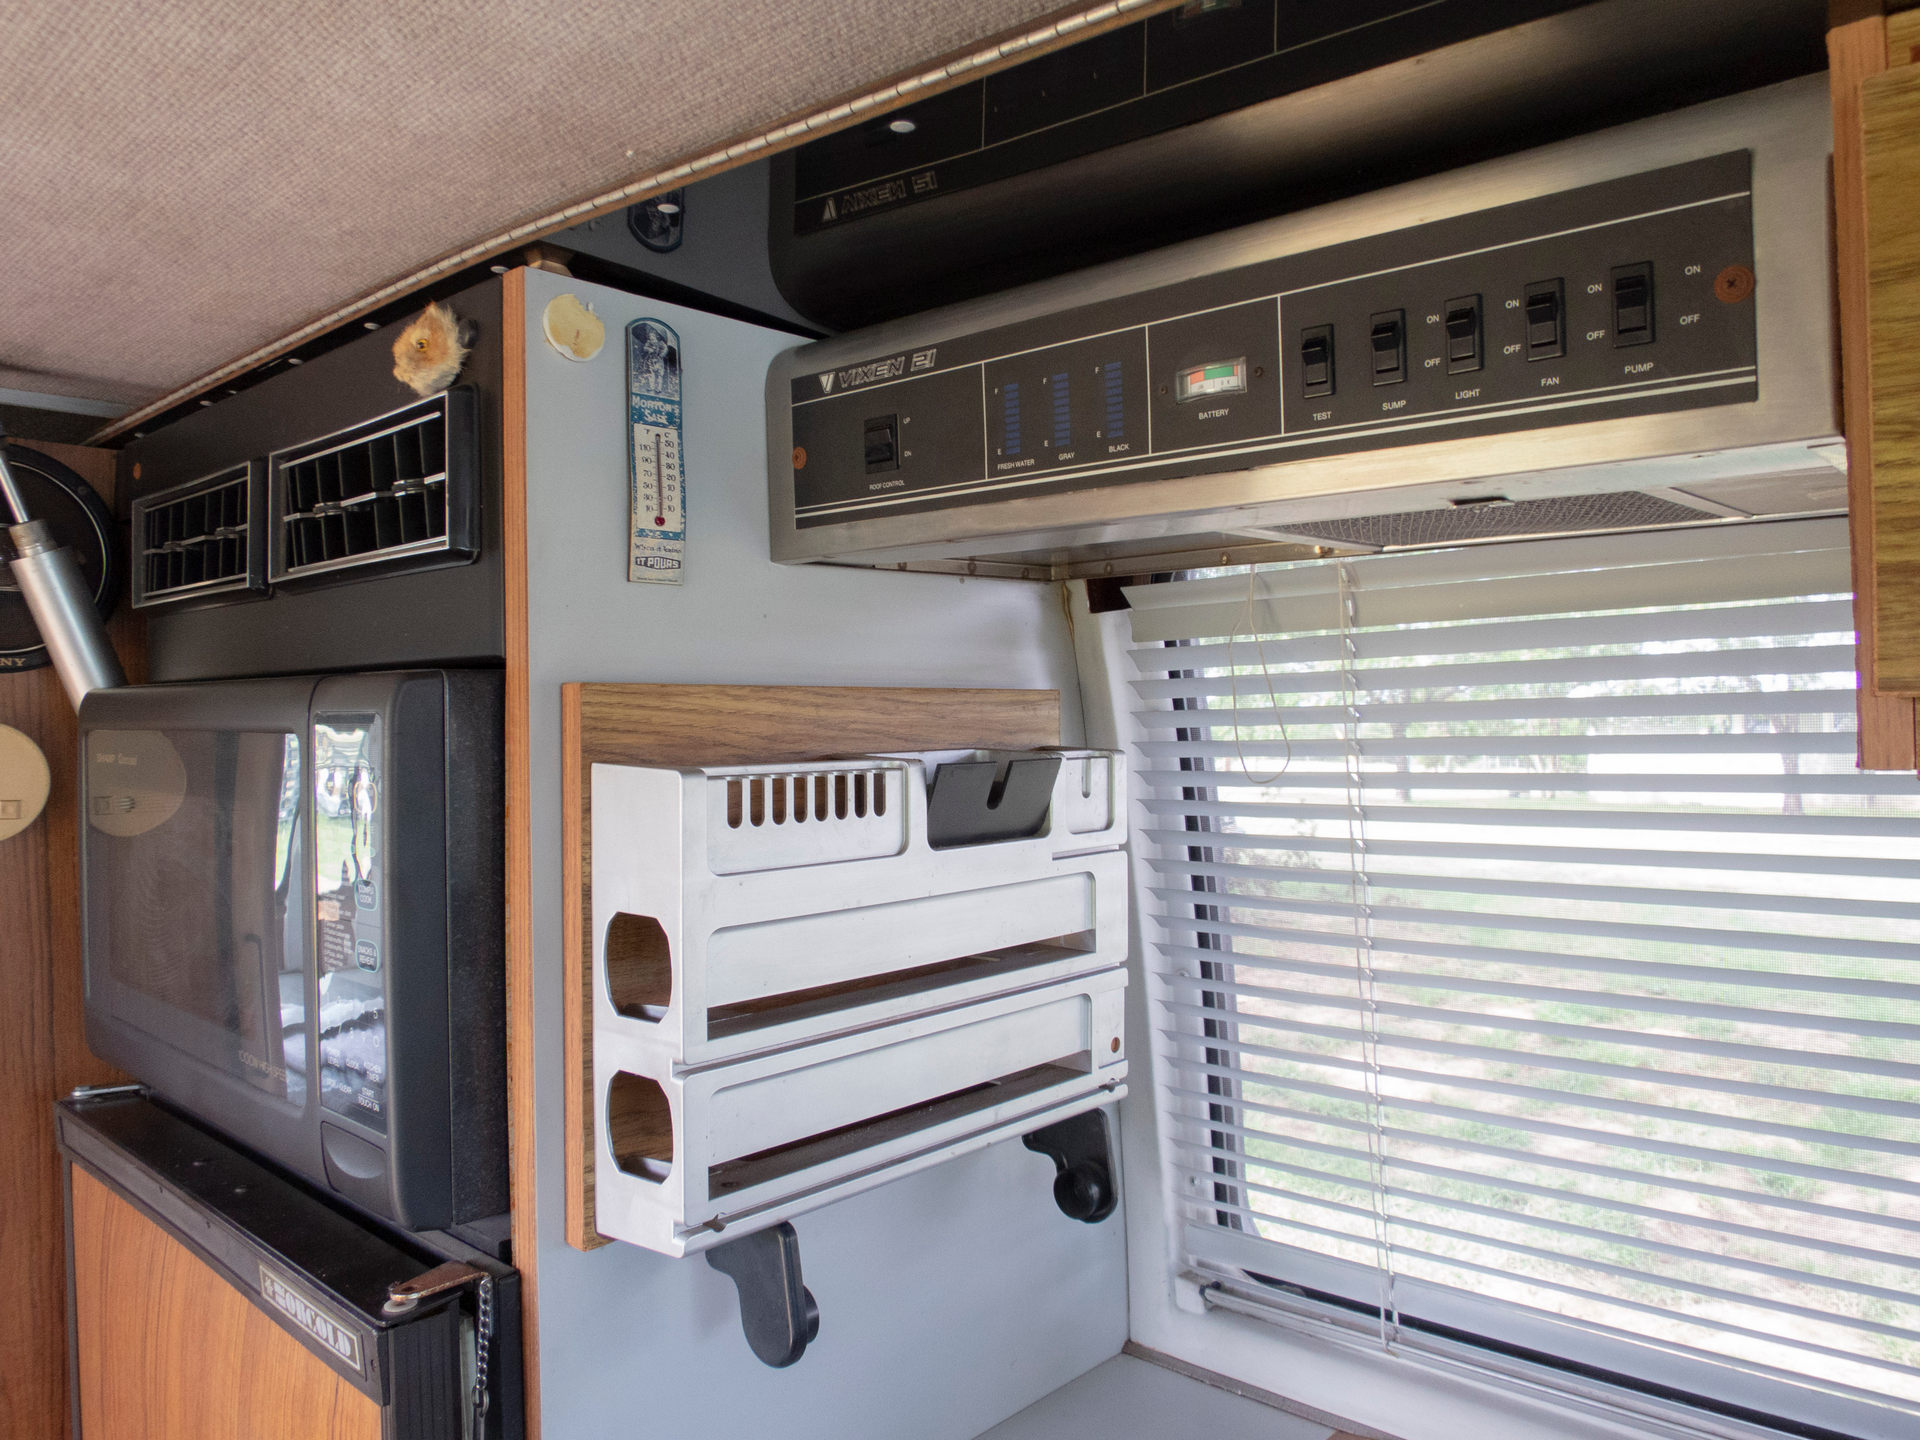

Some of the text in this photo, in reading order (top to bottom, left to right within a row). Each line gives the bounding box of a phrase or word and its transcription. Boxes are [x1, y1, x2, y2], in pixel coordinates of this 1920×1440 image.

[1684, 264, 1701, 275] ON
[1587, 283, 1603, 294] ON
[1505, 299, 1520, 309] ON
[1426, 314, 1440, 324] ON
[1679, 313, 1700, 325] OFF
[1586, 330, 1605, 341] OFF
[1503, 343, 1522, 355] OFF
[1424, 357, 1441, 368] OFF
[839, 356, 906, 389] VIXEN
[1624, 362, 1654, 375] PUMP
[1042, 377, 1047, 385] F
[1540, 376, 1560, 387] FAN
[1455, 388, 1481, 400] LIGHT
[1382, 400, 1407, 411] SUMP
[1198, 408, 1230, 420] BATTERY
[1312, 411, 1332, 422] TEST
[903, 416, 911, 425] UP
[1108, 443, 1130, 453] BLACK
[1058, 452, 1076, 461] GRAY
[997, 459, 1035, 471] FRESH WATER
[869, 479, 905, 491] ROOF CONTROL
[636, 557, 680, 569] IT POURS
[273, 1281, 351, 1357] NORCOLD
